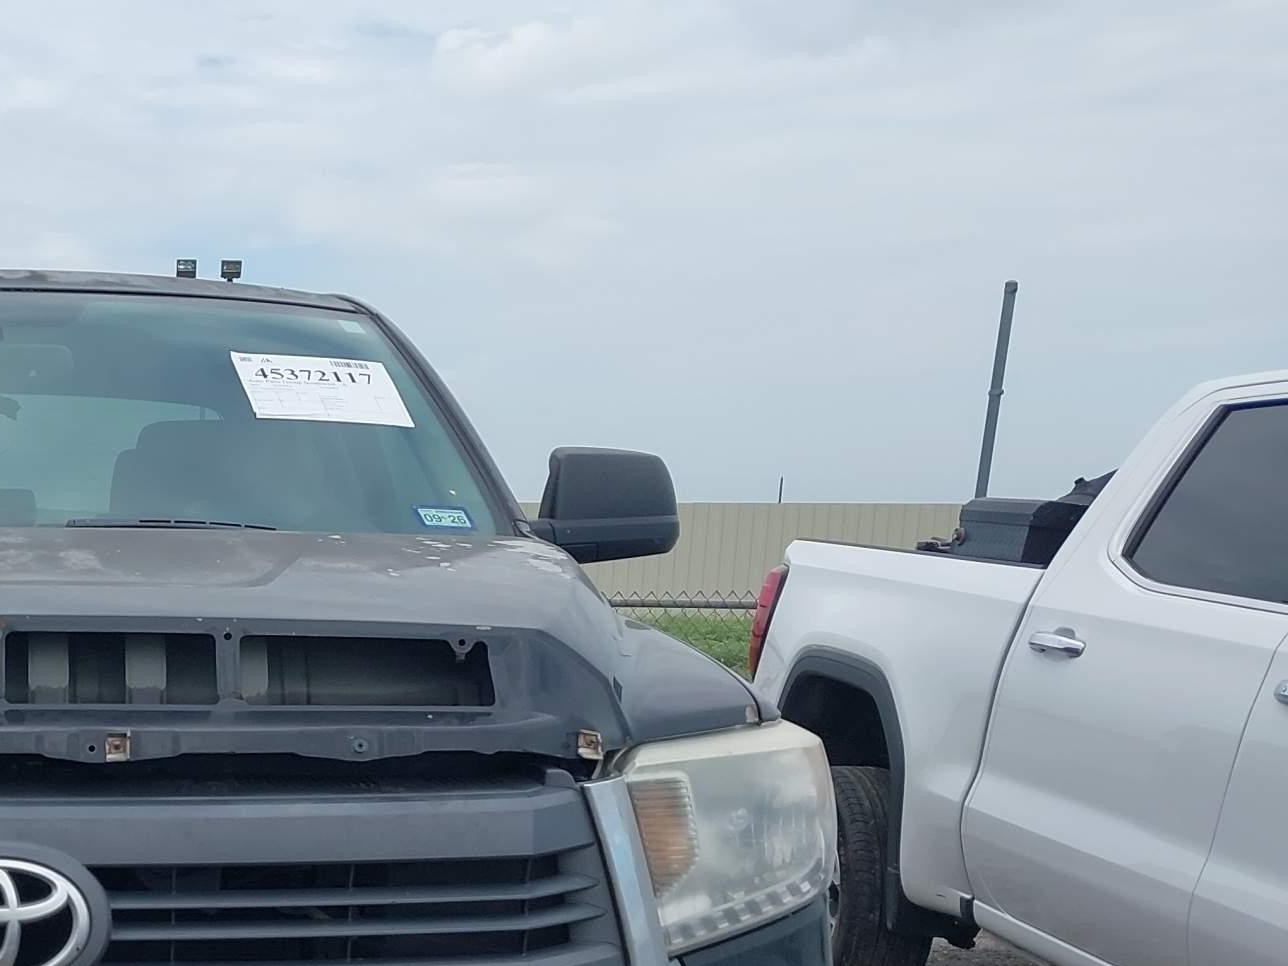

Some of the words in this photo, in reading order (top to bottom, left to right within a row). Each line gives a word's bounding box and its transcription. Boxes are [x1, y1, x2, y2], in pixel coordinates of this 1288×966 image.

[255, 367, 372, 385] 45372117
[423, 513, 442, 523] 09
[448, 514, 466, 524] 26
